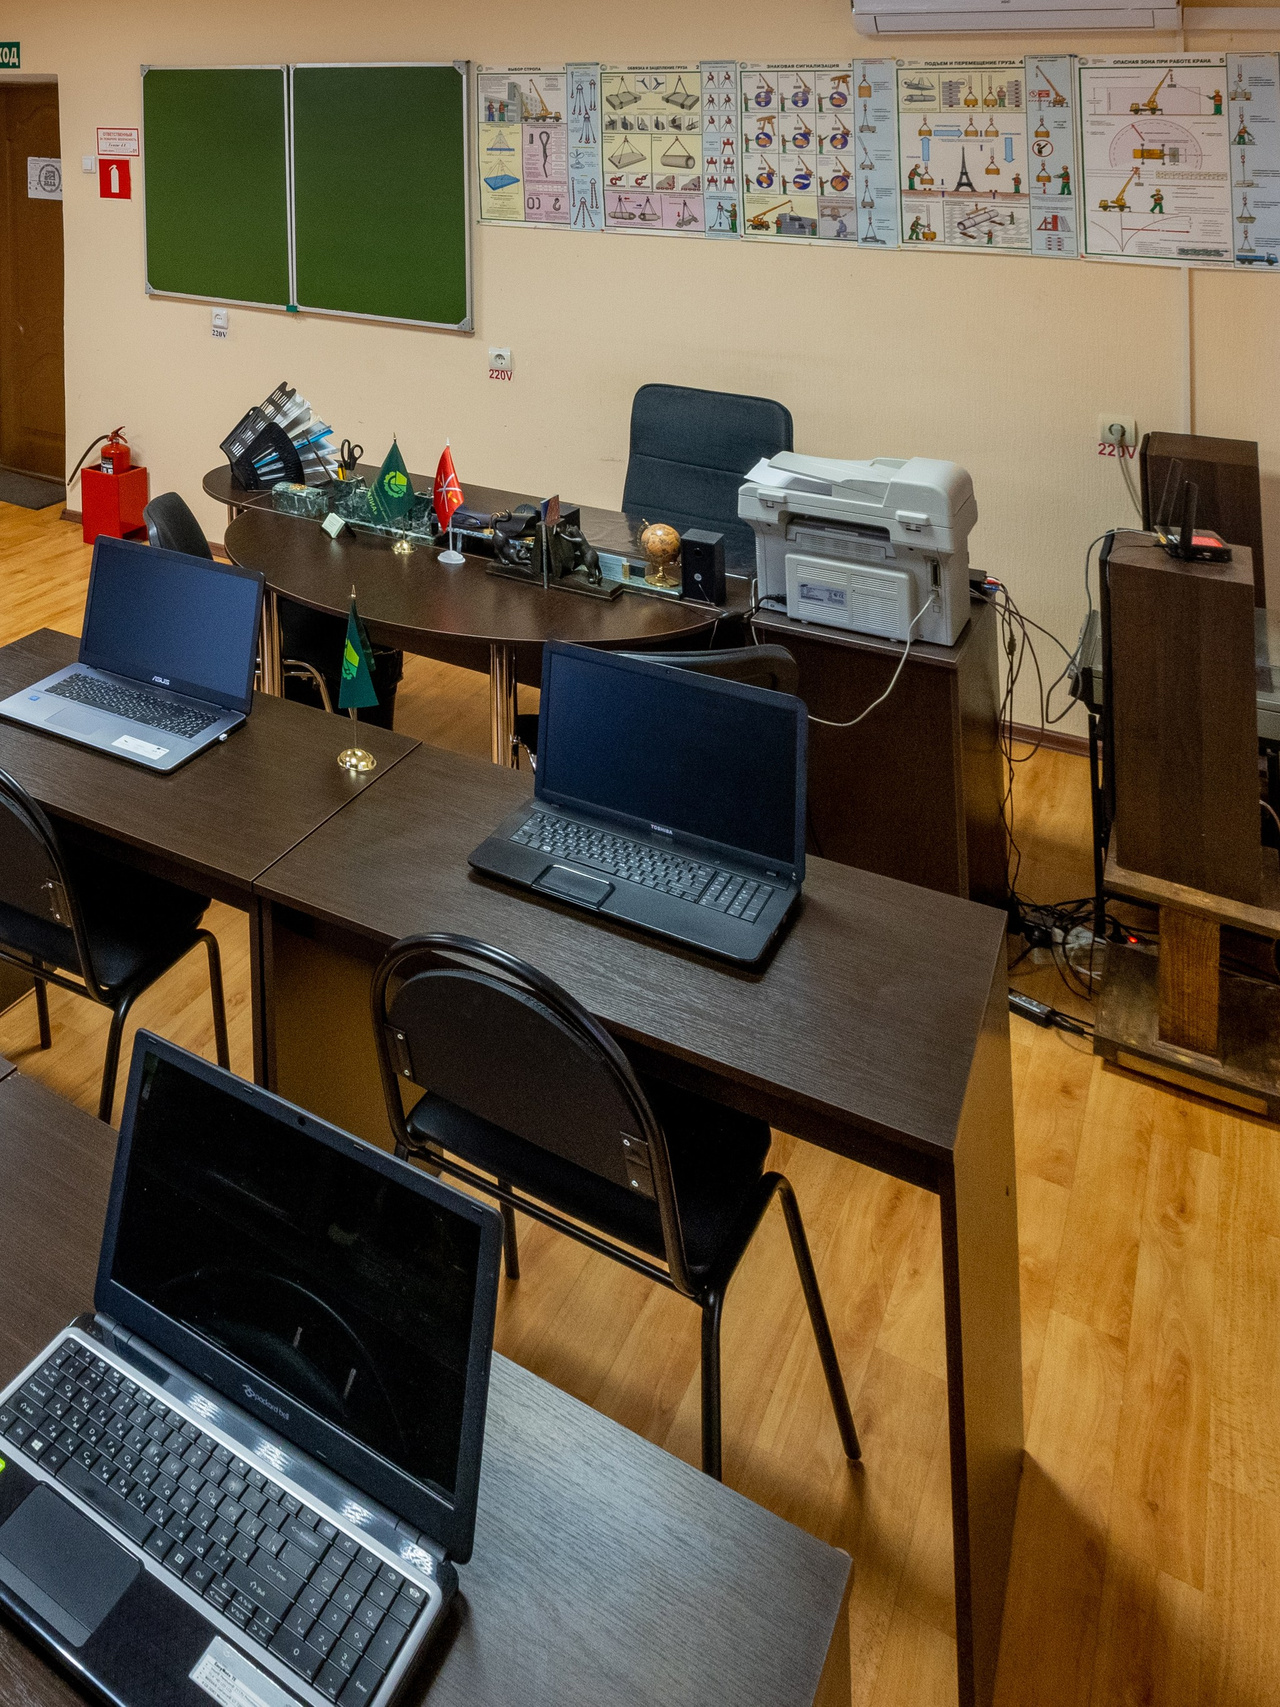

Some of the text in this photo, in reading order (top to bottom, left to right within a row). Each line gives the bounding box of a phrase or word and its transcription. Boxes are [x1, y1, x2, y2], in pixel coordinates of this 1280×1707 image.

[212, 329, 228, 338] 220V
[489, 368, 513, 381] 220V
[152, 675, 170, 686] ASUS
[650, 823, 673, 835] TOSHIBA
